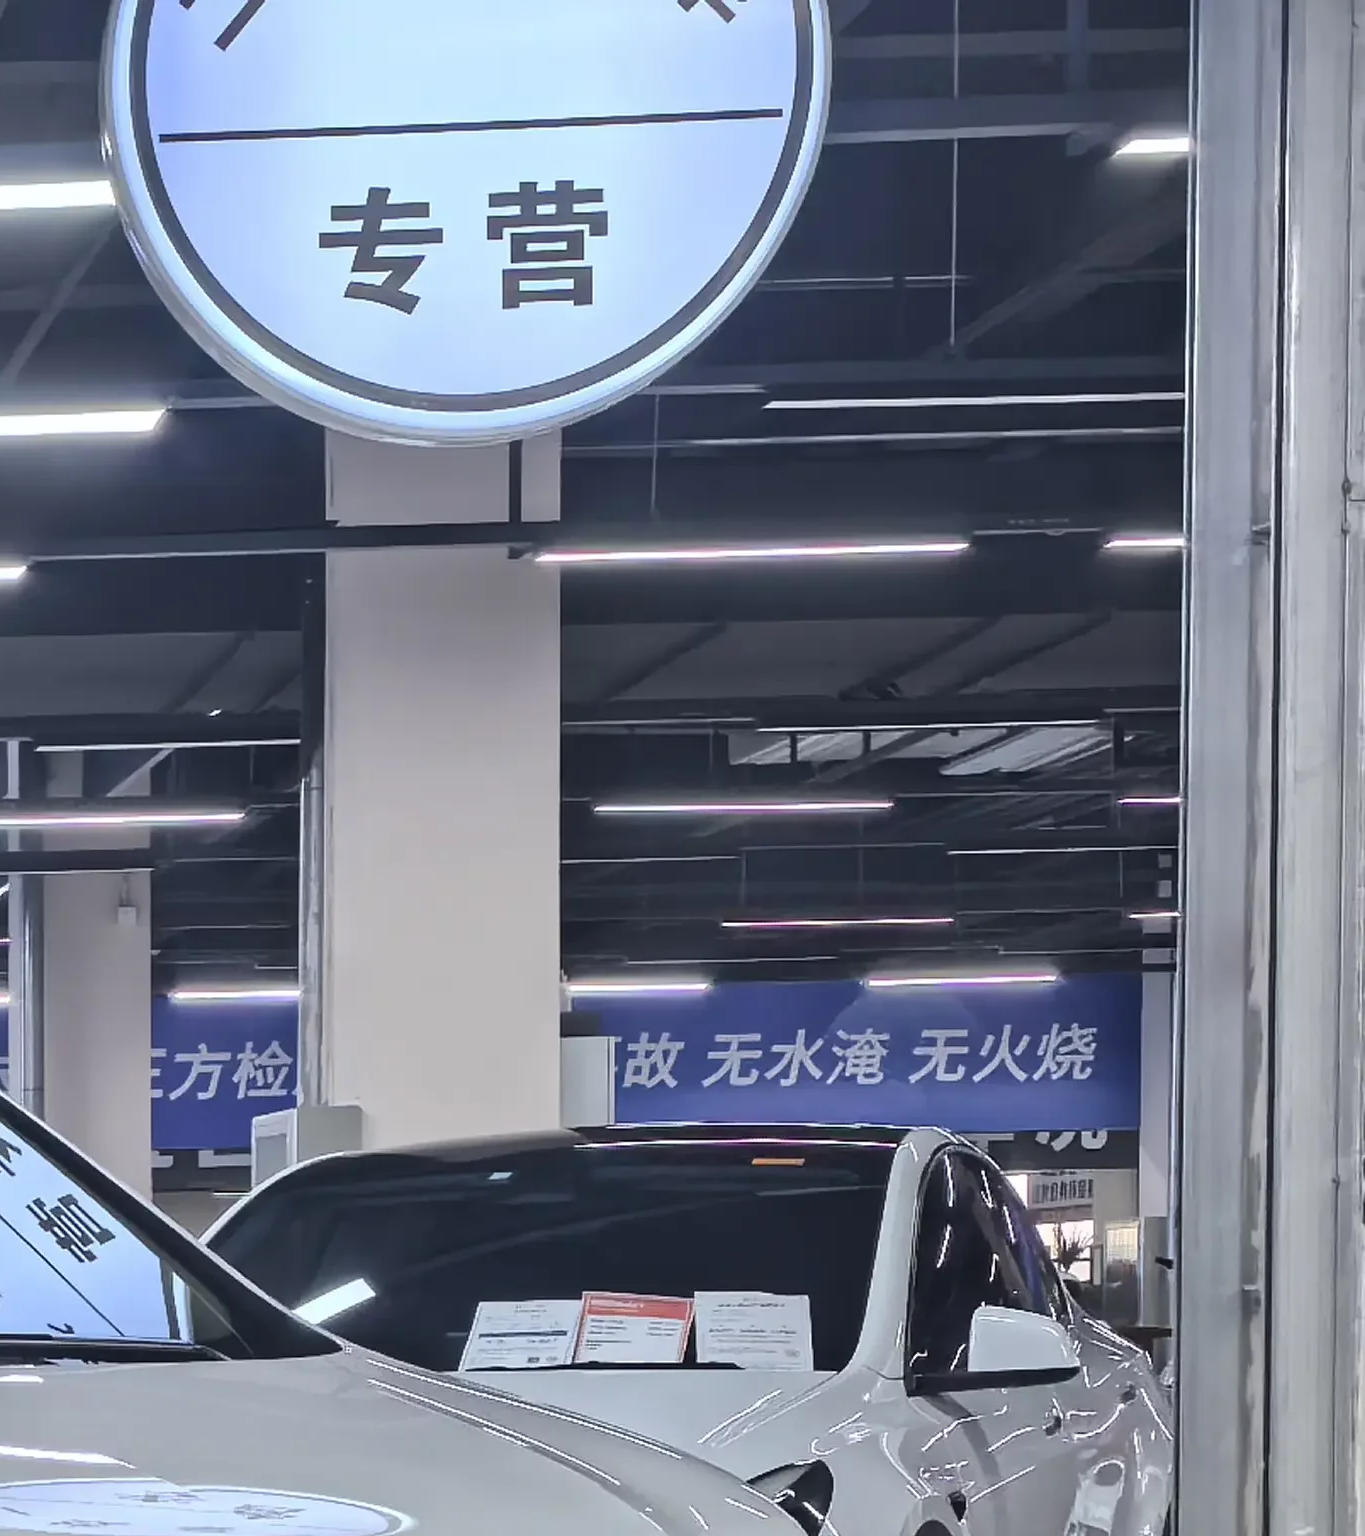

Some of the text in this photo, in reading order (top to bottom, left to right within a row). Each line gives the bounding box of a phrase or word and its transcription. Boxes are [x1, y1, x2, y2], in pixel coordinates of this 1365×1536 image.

[319, 180, 609, 315] 专营
[150, 1022, 1098, 1100] 方检 故 无水淹 无火烧
